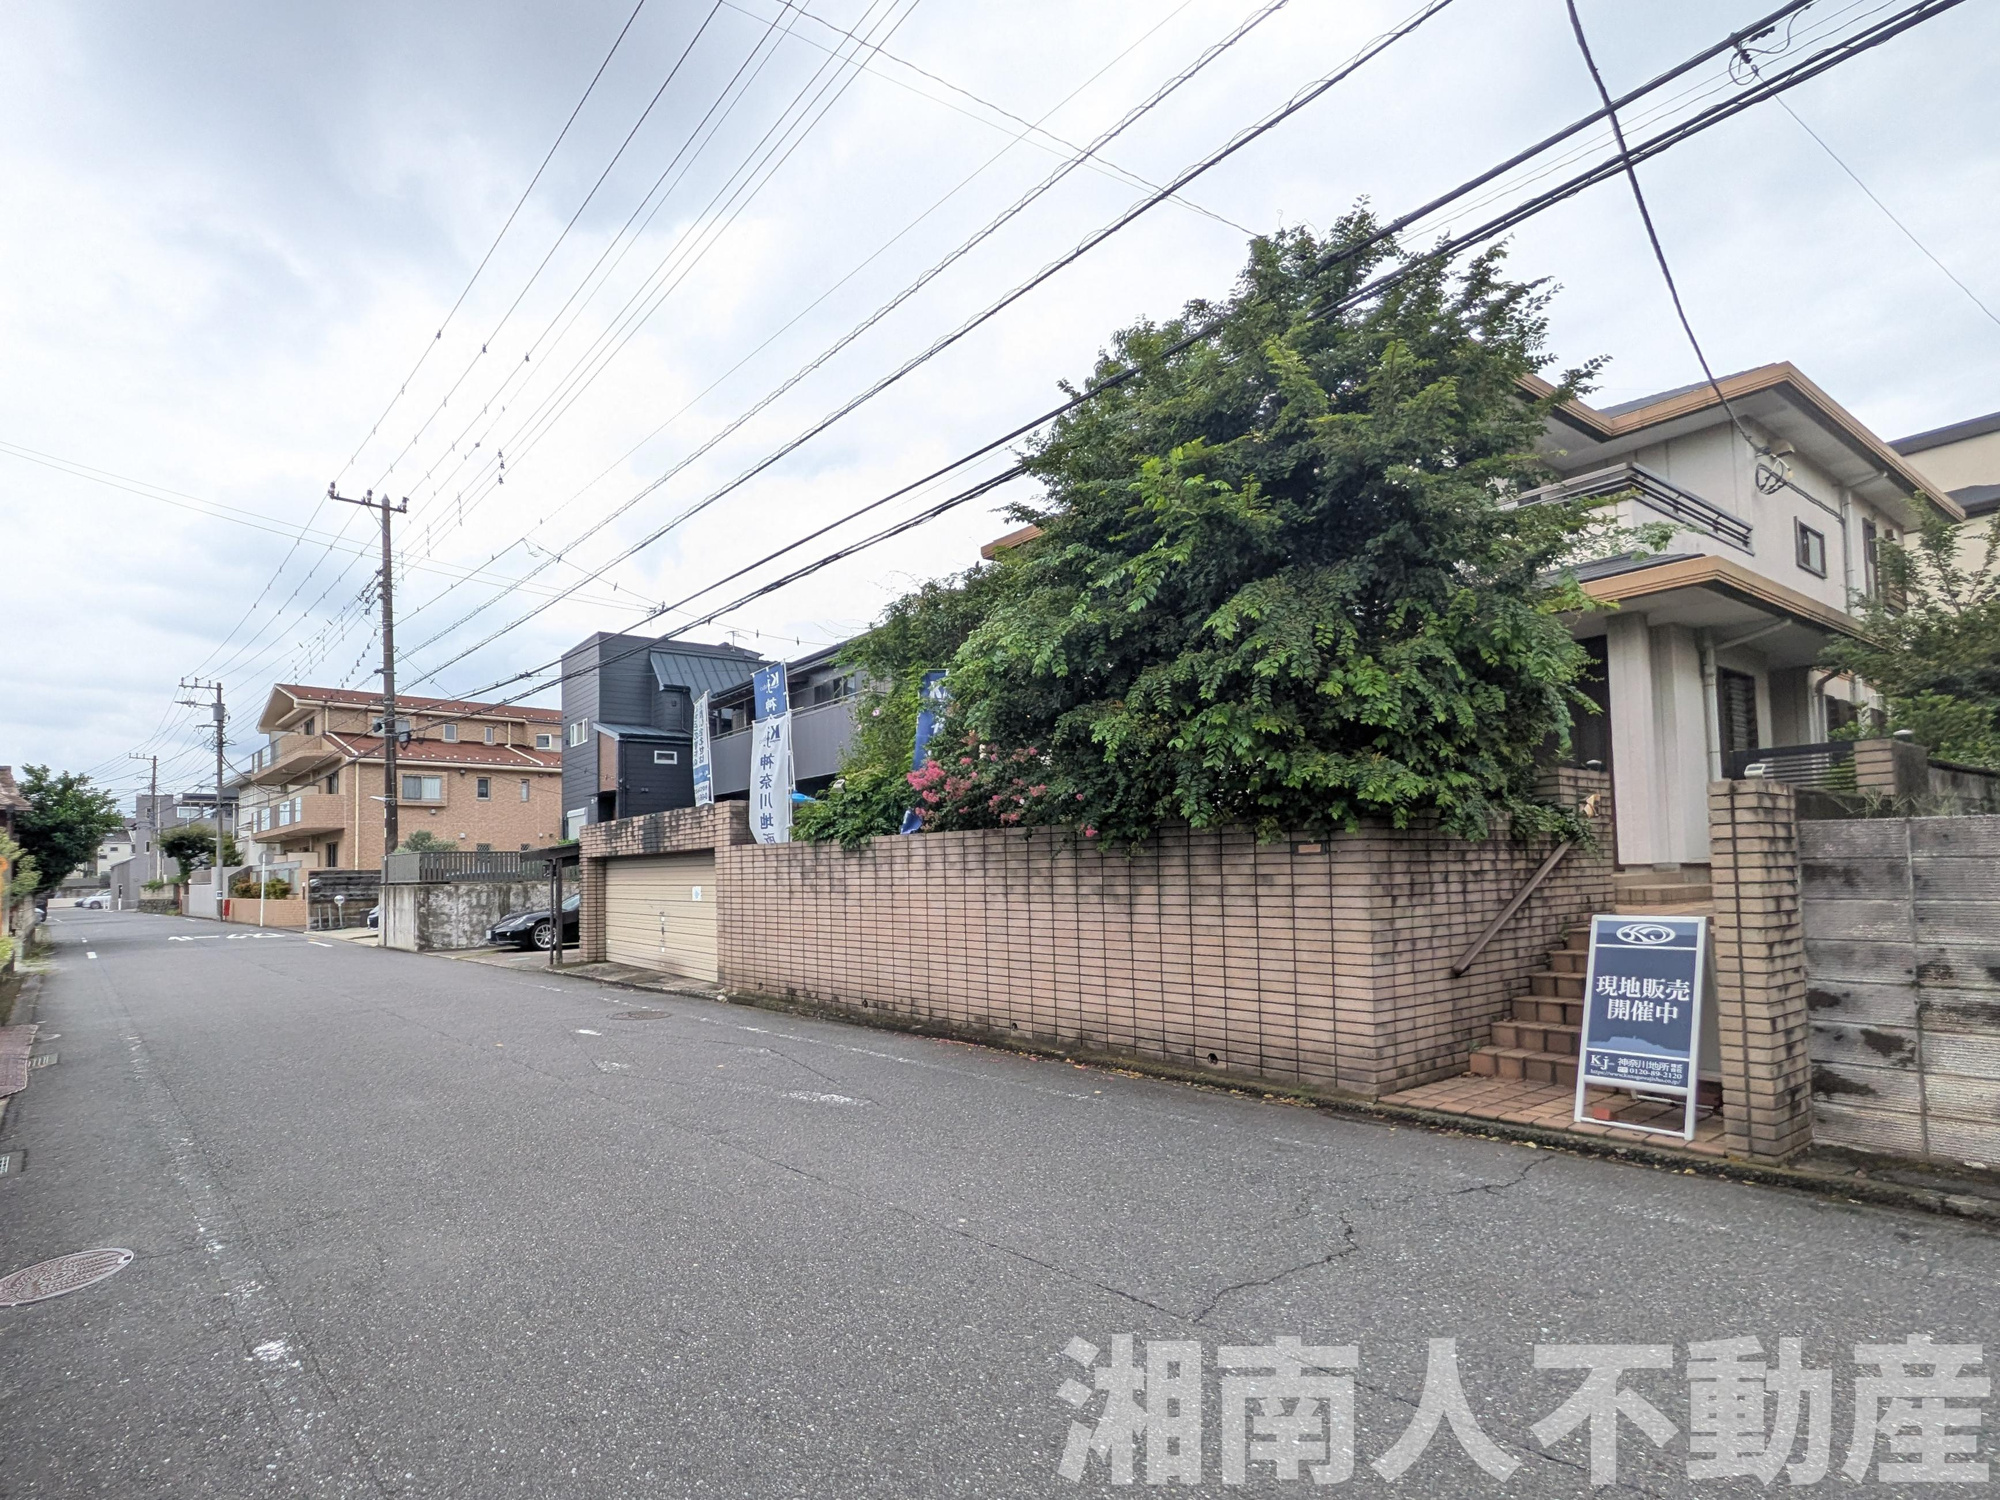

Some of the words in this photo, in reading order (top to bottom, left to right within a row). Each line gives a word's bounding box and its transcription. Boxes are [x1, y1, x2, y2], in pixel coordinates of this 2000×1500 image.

[1595, 975, 1690, 1001] 現地販売
[1607, 998, 1678, 1024] 開催中
[1617, 1057, 1670, 1072] 神奈川地所
